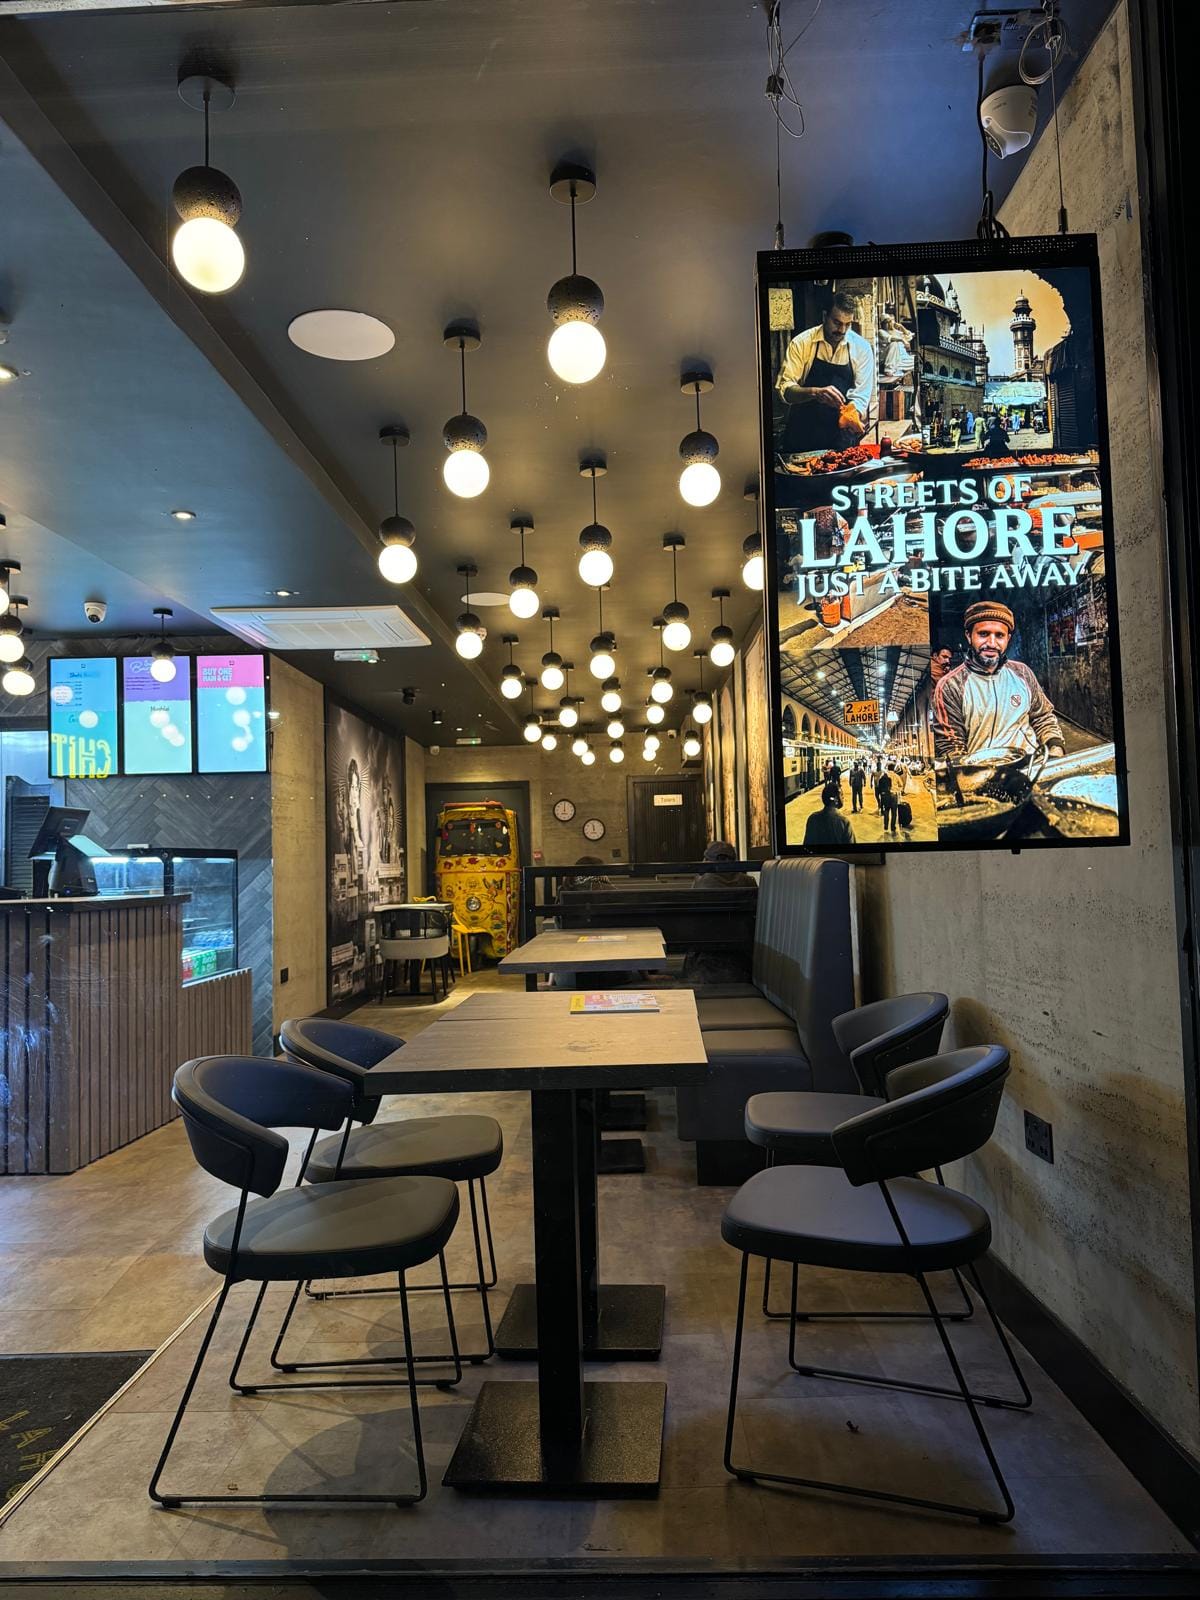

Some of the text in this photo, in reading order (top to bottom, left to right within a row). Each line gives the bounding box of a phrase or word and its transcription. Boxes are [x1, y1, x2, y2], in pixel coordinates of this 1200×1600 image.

[831, 476, 1032, 511] STREETS OF
[799, 506, 1079, 568] LAHORE
[796, 561, 1085, 605] JUST A BITE AWAY
[845, 713, 879, 723] LAHORE
[846, 703, 854, 713] 2
